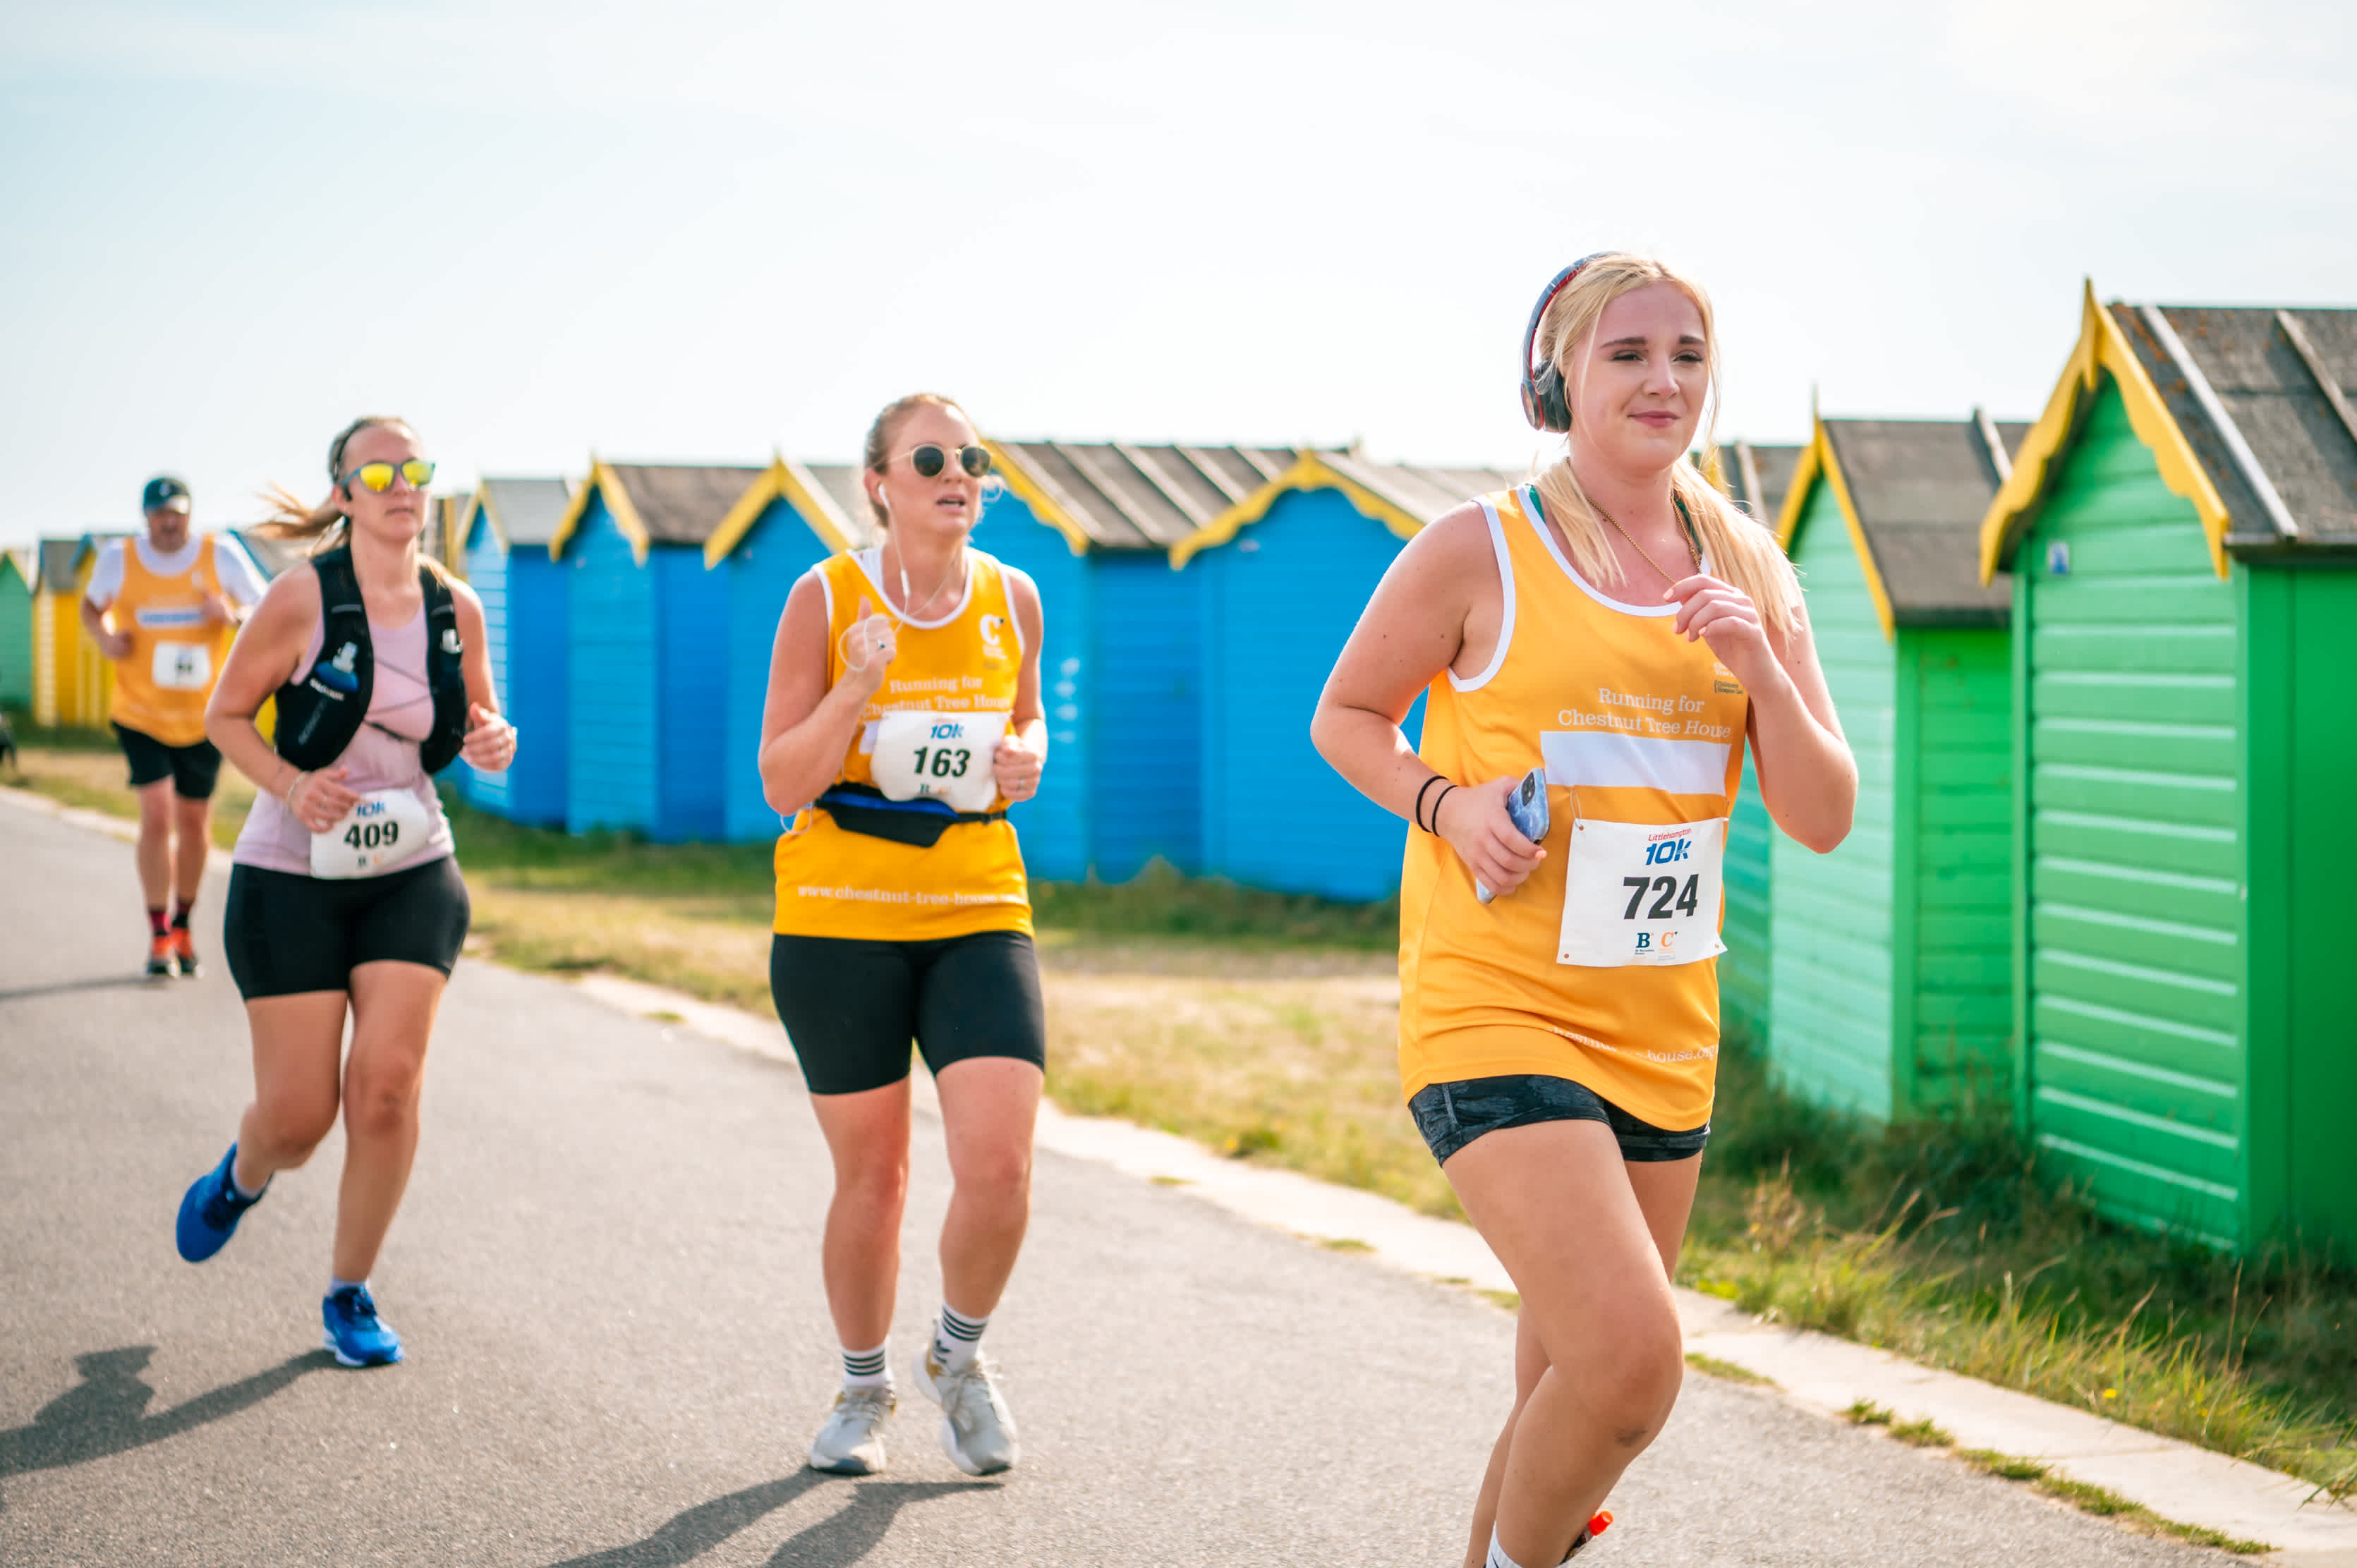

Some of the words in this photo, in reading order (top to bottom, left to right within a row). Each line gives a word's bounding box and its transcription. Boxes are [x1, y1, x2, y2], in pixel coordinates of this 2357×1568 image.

[890, 677, 958, 693] Running
[962, 675, 983, 689] for
[934, 695, 969, 710] Tree
[1599, 688, 1675, 715] Running
[1679, 695, 1704, 712] for
[1558, 708, 1642, 731] Chestnut
[1645, 717, 1680, 734] Tree
[914, 745, 971, 777] 163
[344, 820, 399, 849] 409
[1648, 828, 1692, 841] Littlehampton
[1623, 873, 1699, 920] 724
